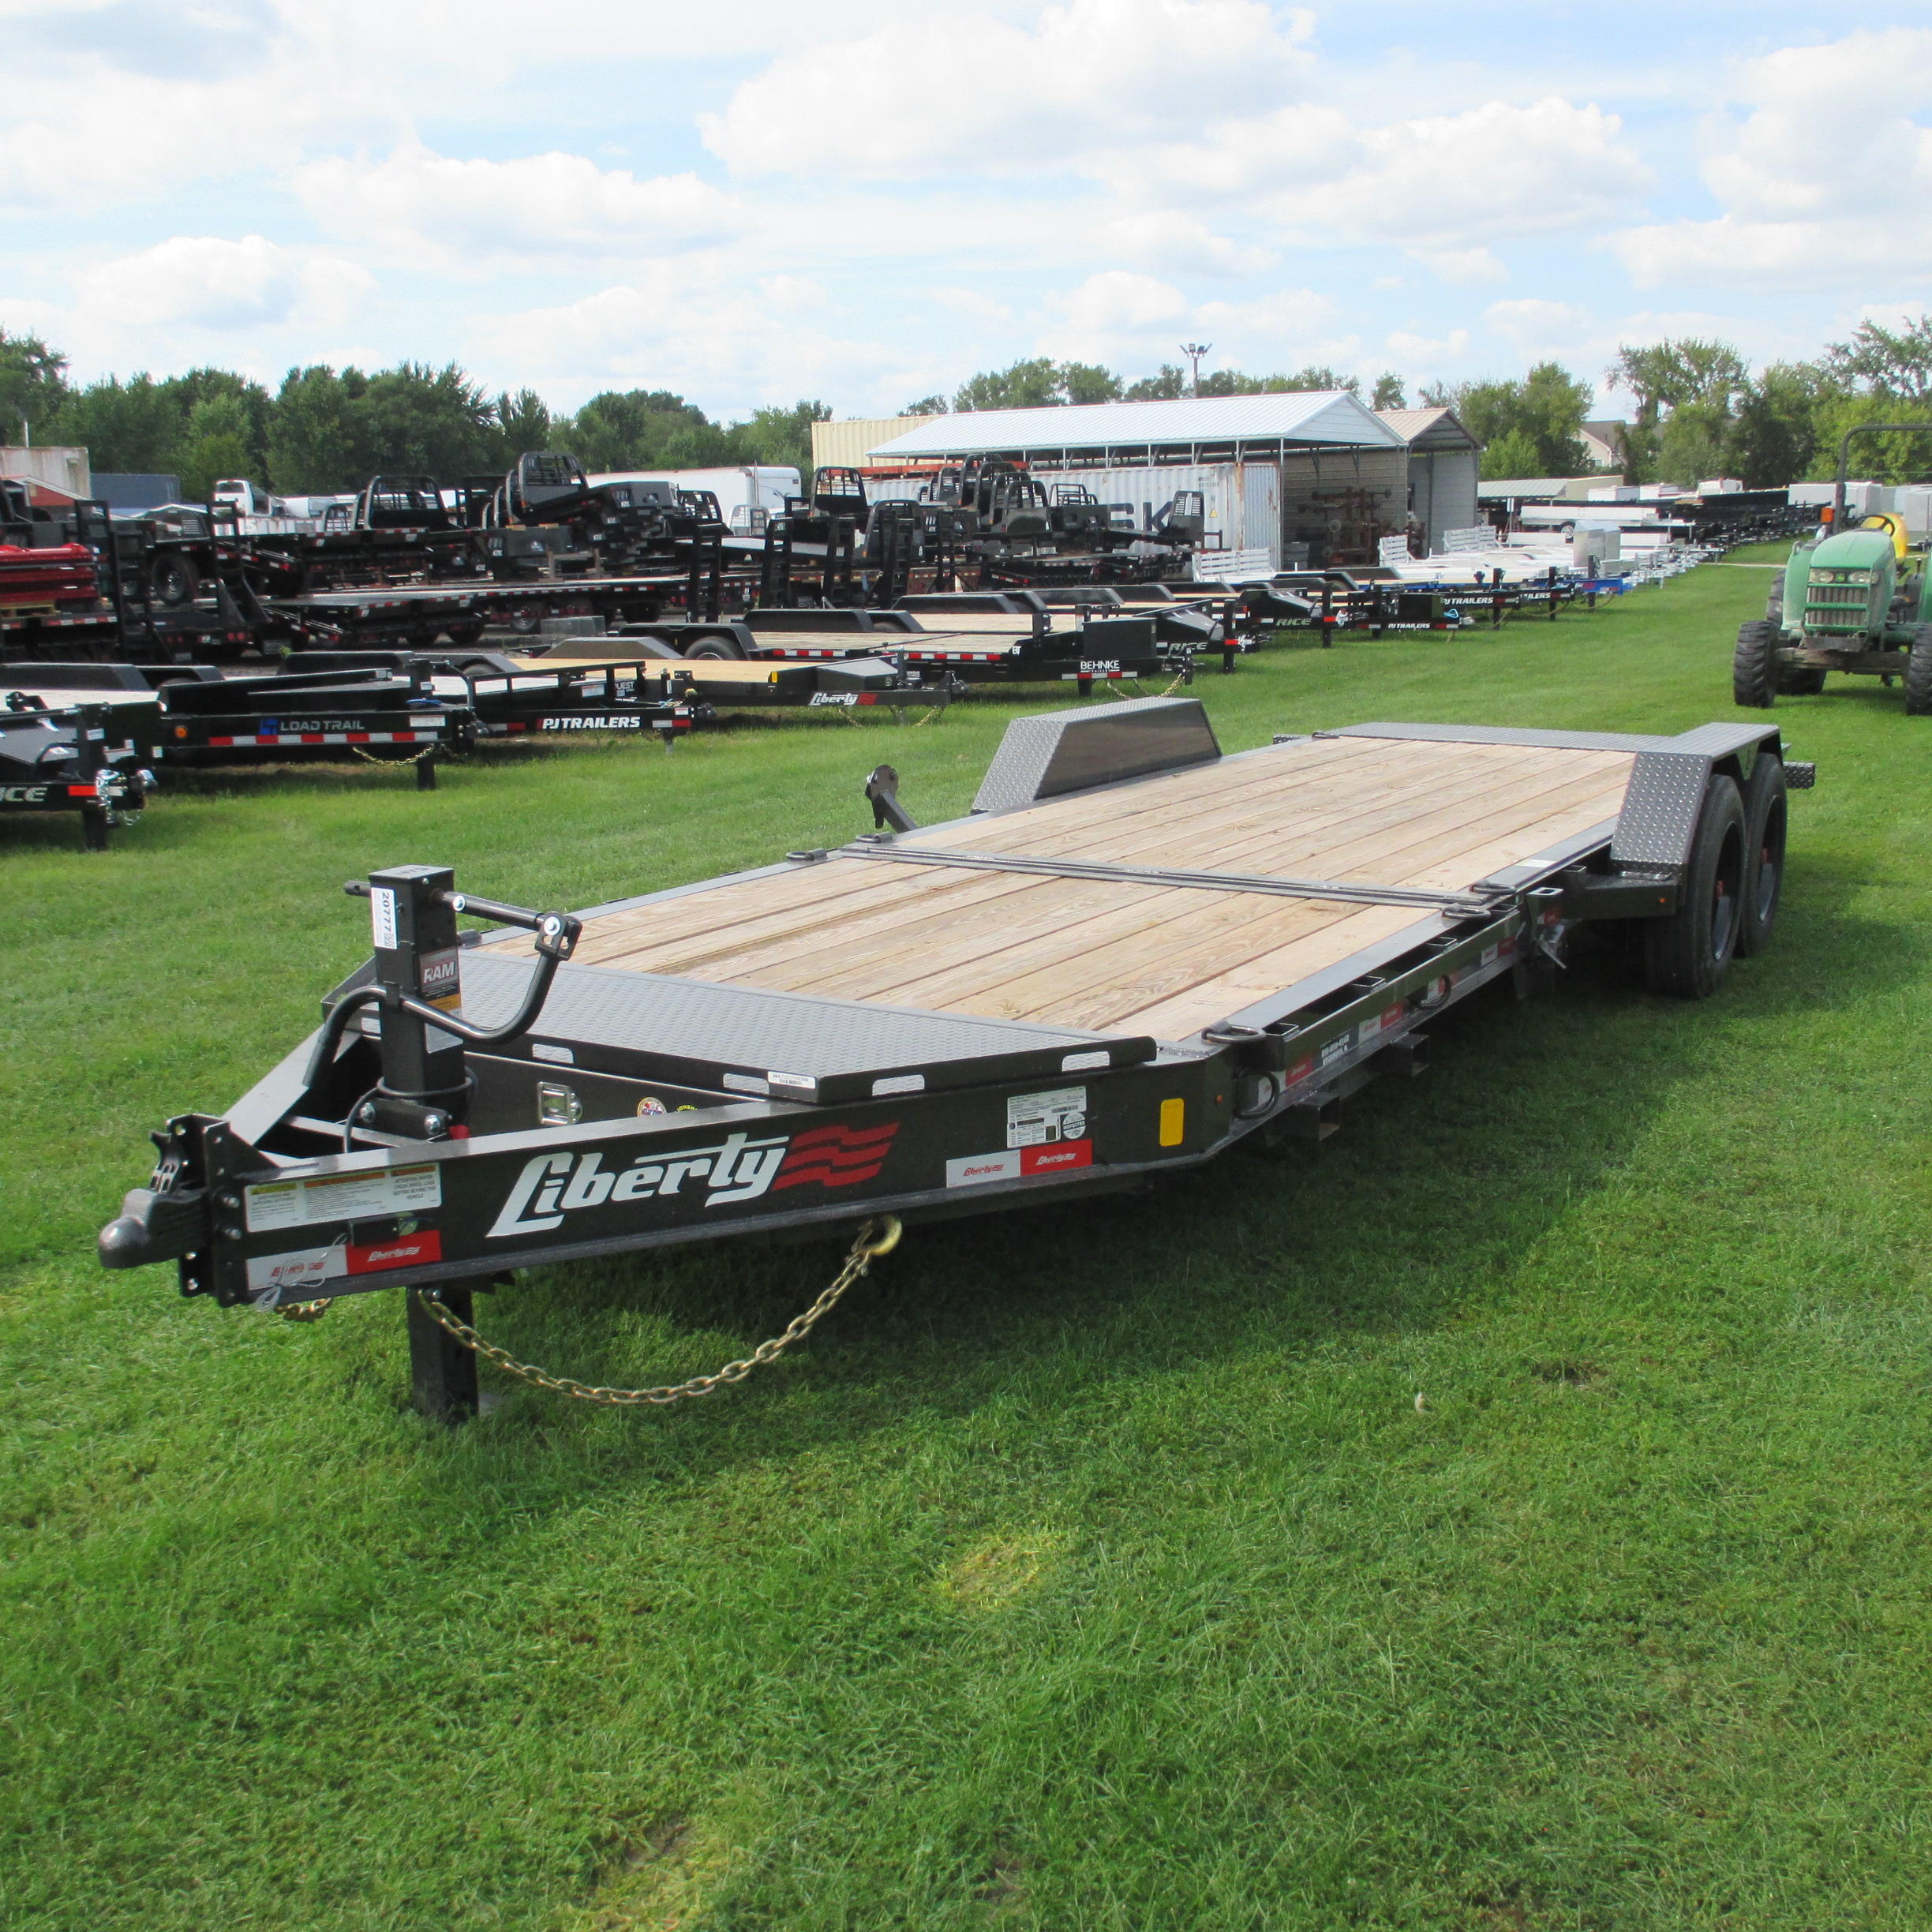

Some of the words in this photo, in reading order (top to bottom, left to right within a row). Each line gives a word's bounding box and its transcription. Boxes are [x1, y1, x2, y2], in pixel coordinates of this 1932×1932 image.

[1080, 660, 1120, 670] BEHNKE
[808, 692, 859, 706] Liberty
[280, 721, 320, 731] LOAD
[323, 720, 365, 730] TRAIL
[542, 718, 560, 729] PJ
[560, 717, 641, 728] TRAILERS
[382, 892, 392, 932] 20777
[423, 960, 456, 983] RAM
[963, 1165, 994, 1177] Liberty
[1035, 1153, 1067, 1166] Liberty
[485, 1132, 789, 1238] Liberty
[368, 1248, 406, 1262] Liberty
